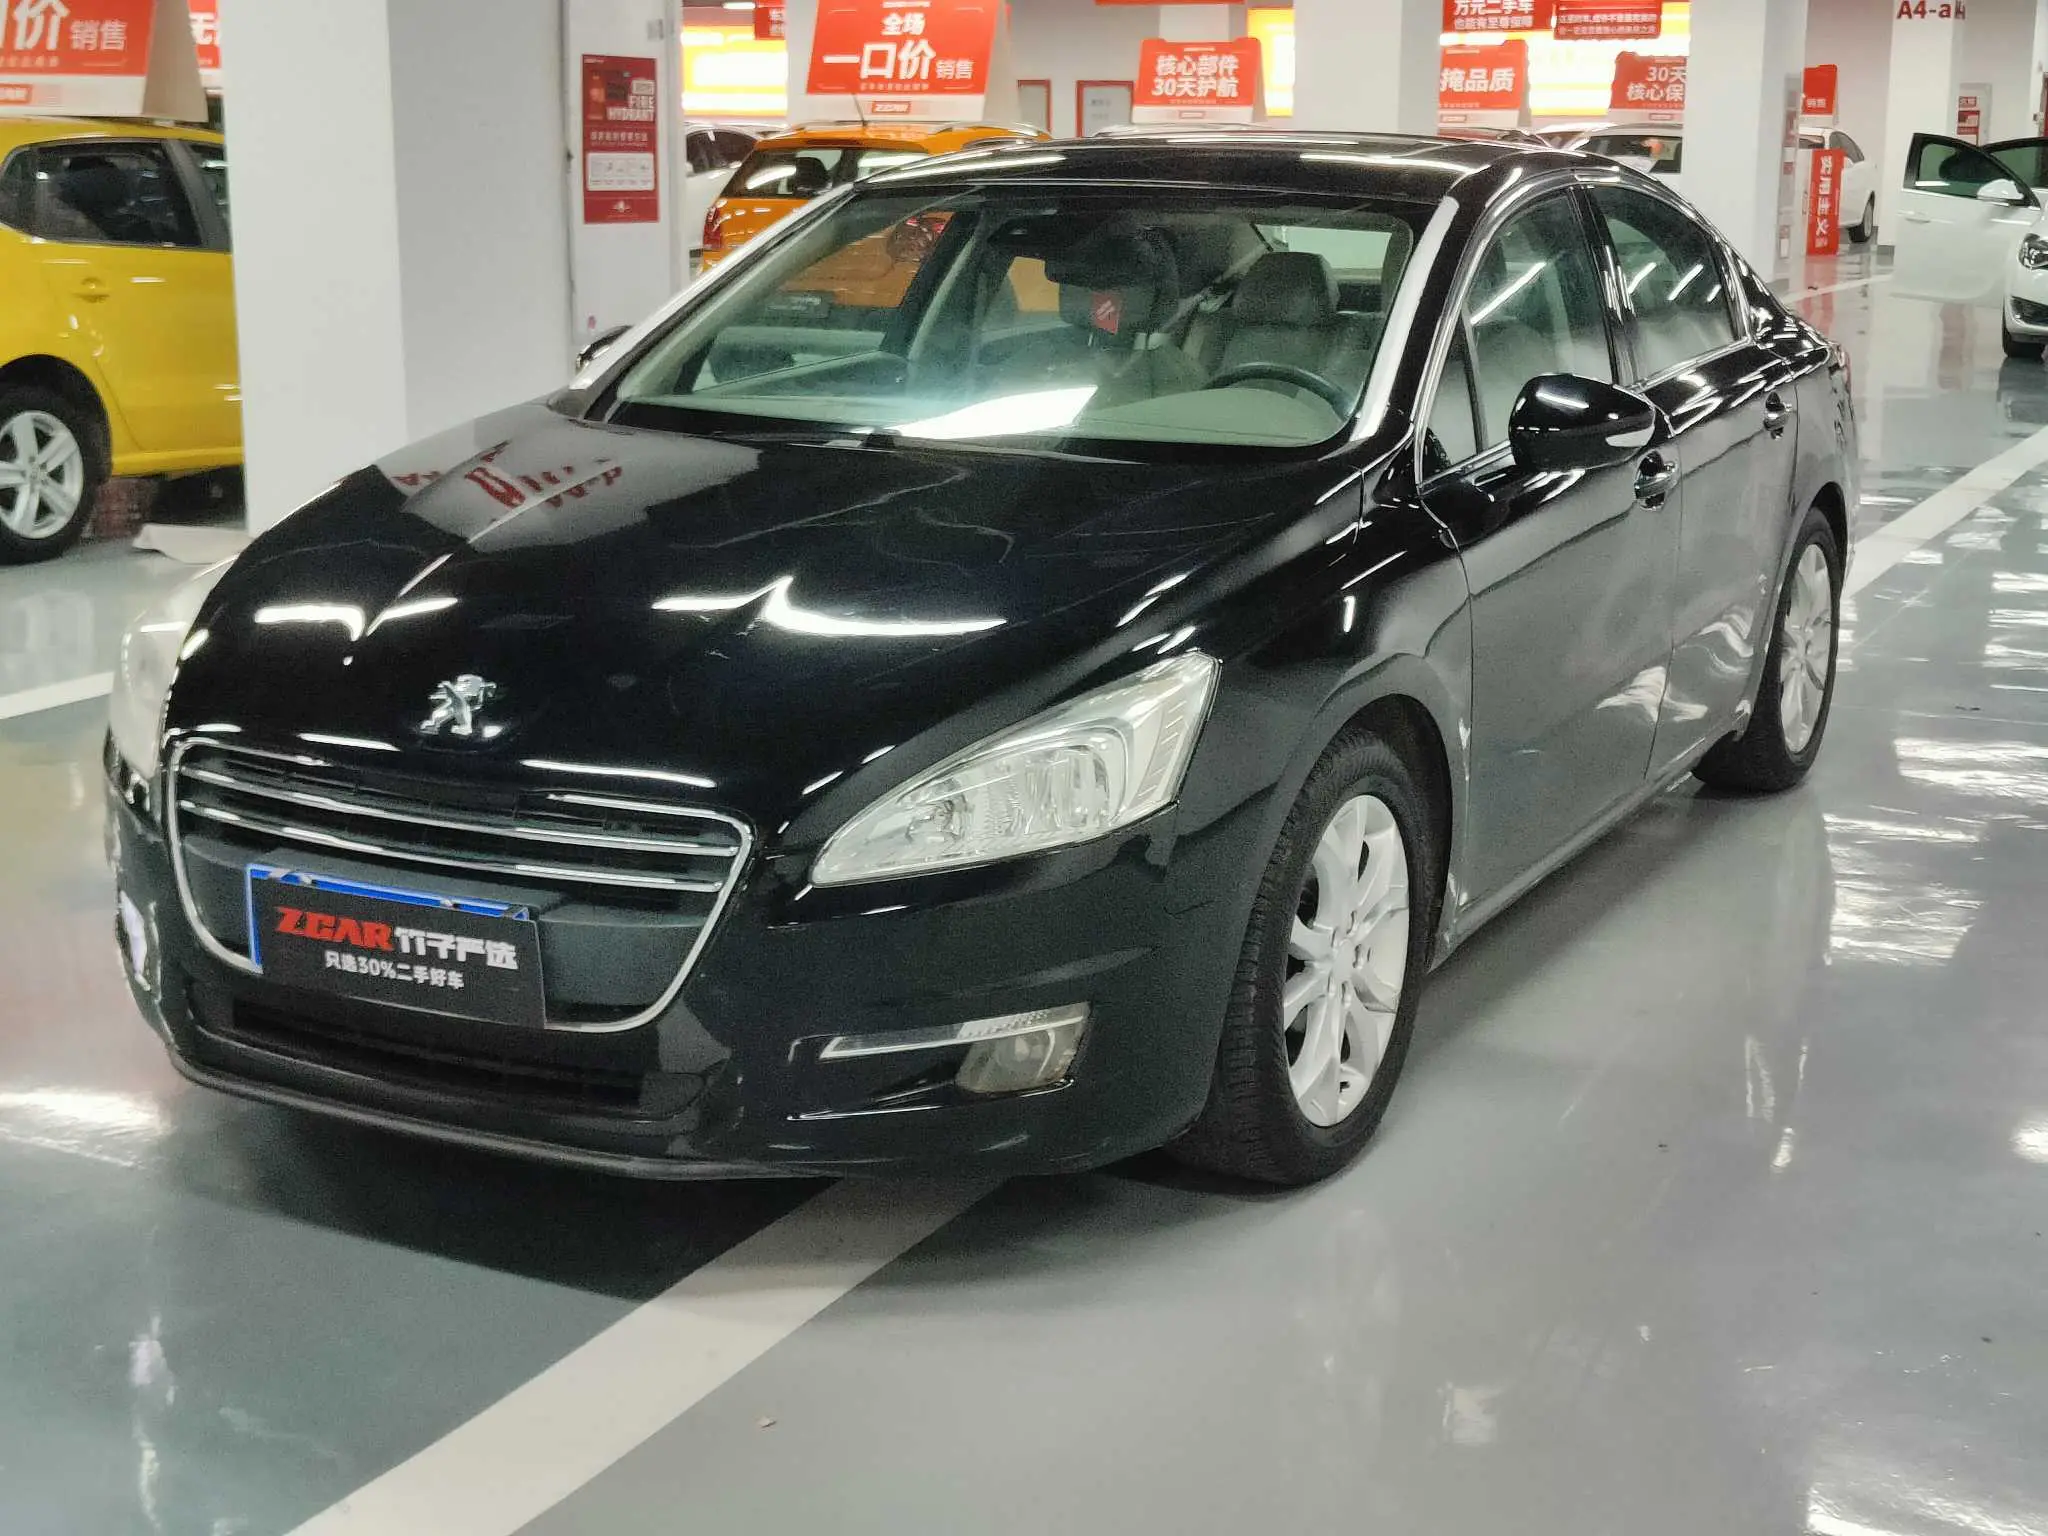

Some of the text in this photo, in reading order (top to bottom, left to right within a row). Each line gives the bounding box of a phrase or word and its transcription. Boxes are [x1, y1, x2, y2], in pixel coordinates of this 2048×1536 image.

[70, 19, 128, 50] 销售
[881, 12, 926, 36] 全场
[822, 39, 974, 80] 一口价 销售
[1156, 54, 1238, 76] 核心部件
[1151, 77, 1238, 98] 30天护航
[394, 928, 518, 969] 竹子严选
[325, 951, 464, 989] 只选30%二手好车
